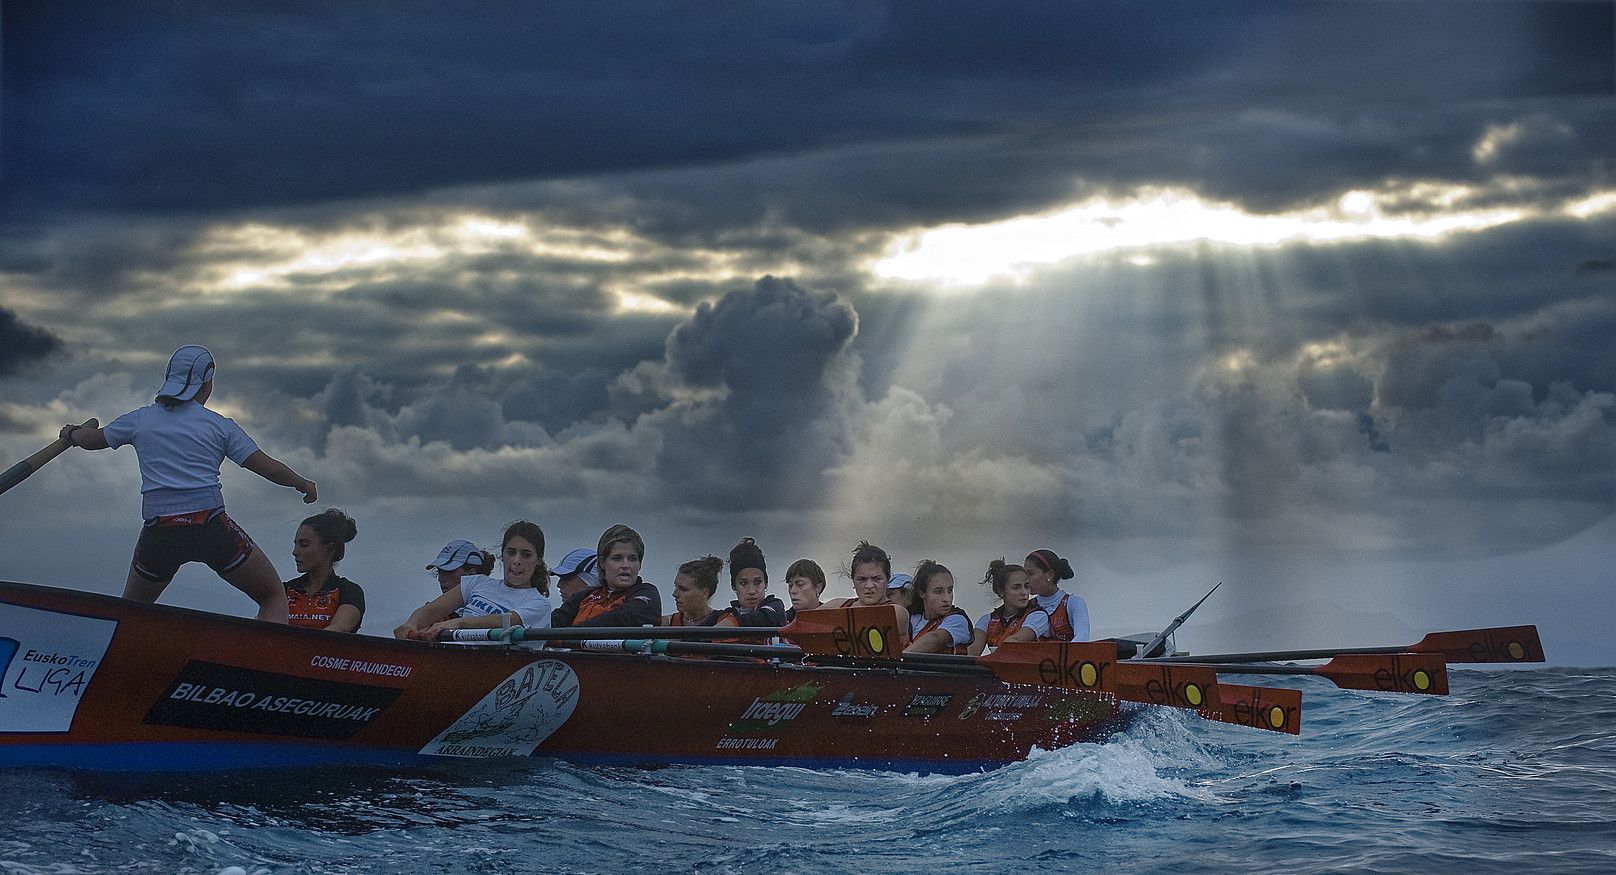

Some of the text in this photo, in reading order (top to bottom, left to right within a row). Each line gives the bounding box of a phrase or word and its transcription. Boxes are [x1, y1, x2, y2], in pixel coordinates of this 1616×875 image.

[833, 607, 892, 658] elkor
[1470, 630, 1533, 660] elkor
[23, 650, 97, 668] EuskoTren
[310, 655, 413, 678] COSME IRAUNDEGUI
[1038, 643, 1110, 691] elkor
[1375, 654, 1440, 692] elkor
[14, 666, 86, 696] LIGA
[495, 661, 579, 710] BATELA
[1146, 665, 1213, 708] elkor
[169, 682, 381, 722] BILBAO ASEGURUAK
[740, 696, 807, 726] Iraegui
[1234, 690, 1297, 730] elkor
[715, 738, 780, 750] ERROTULOAK
